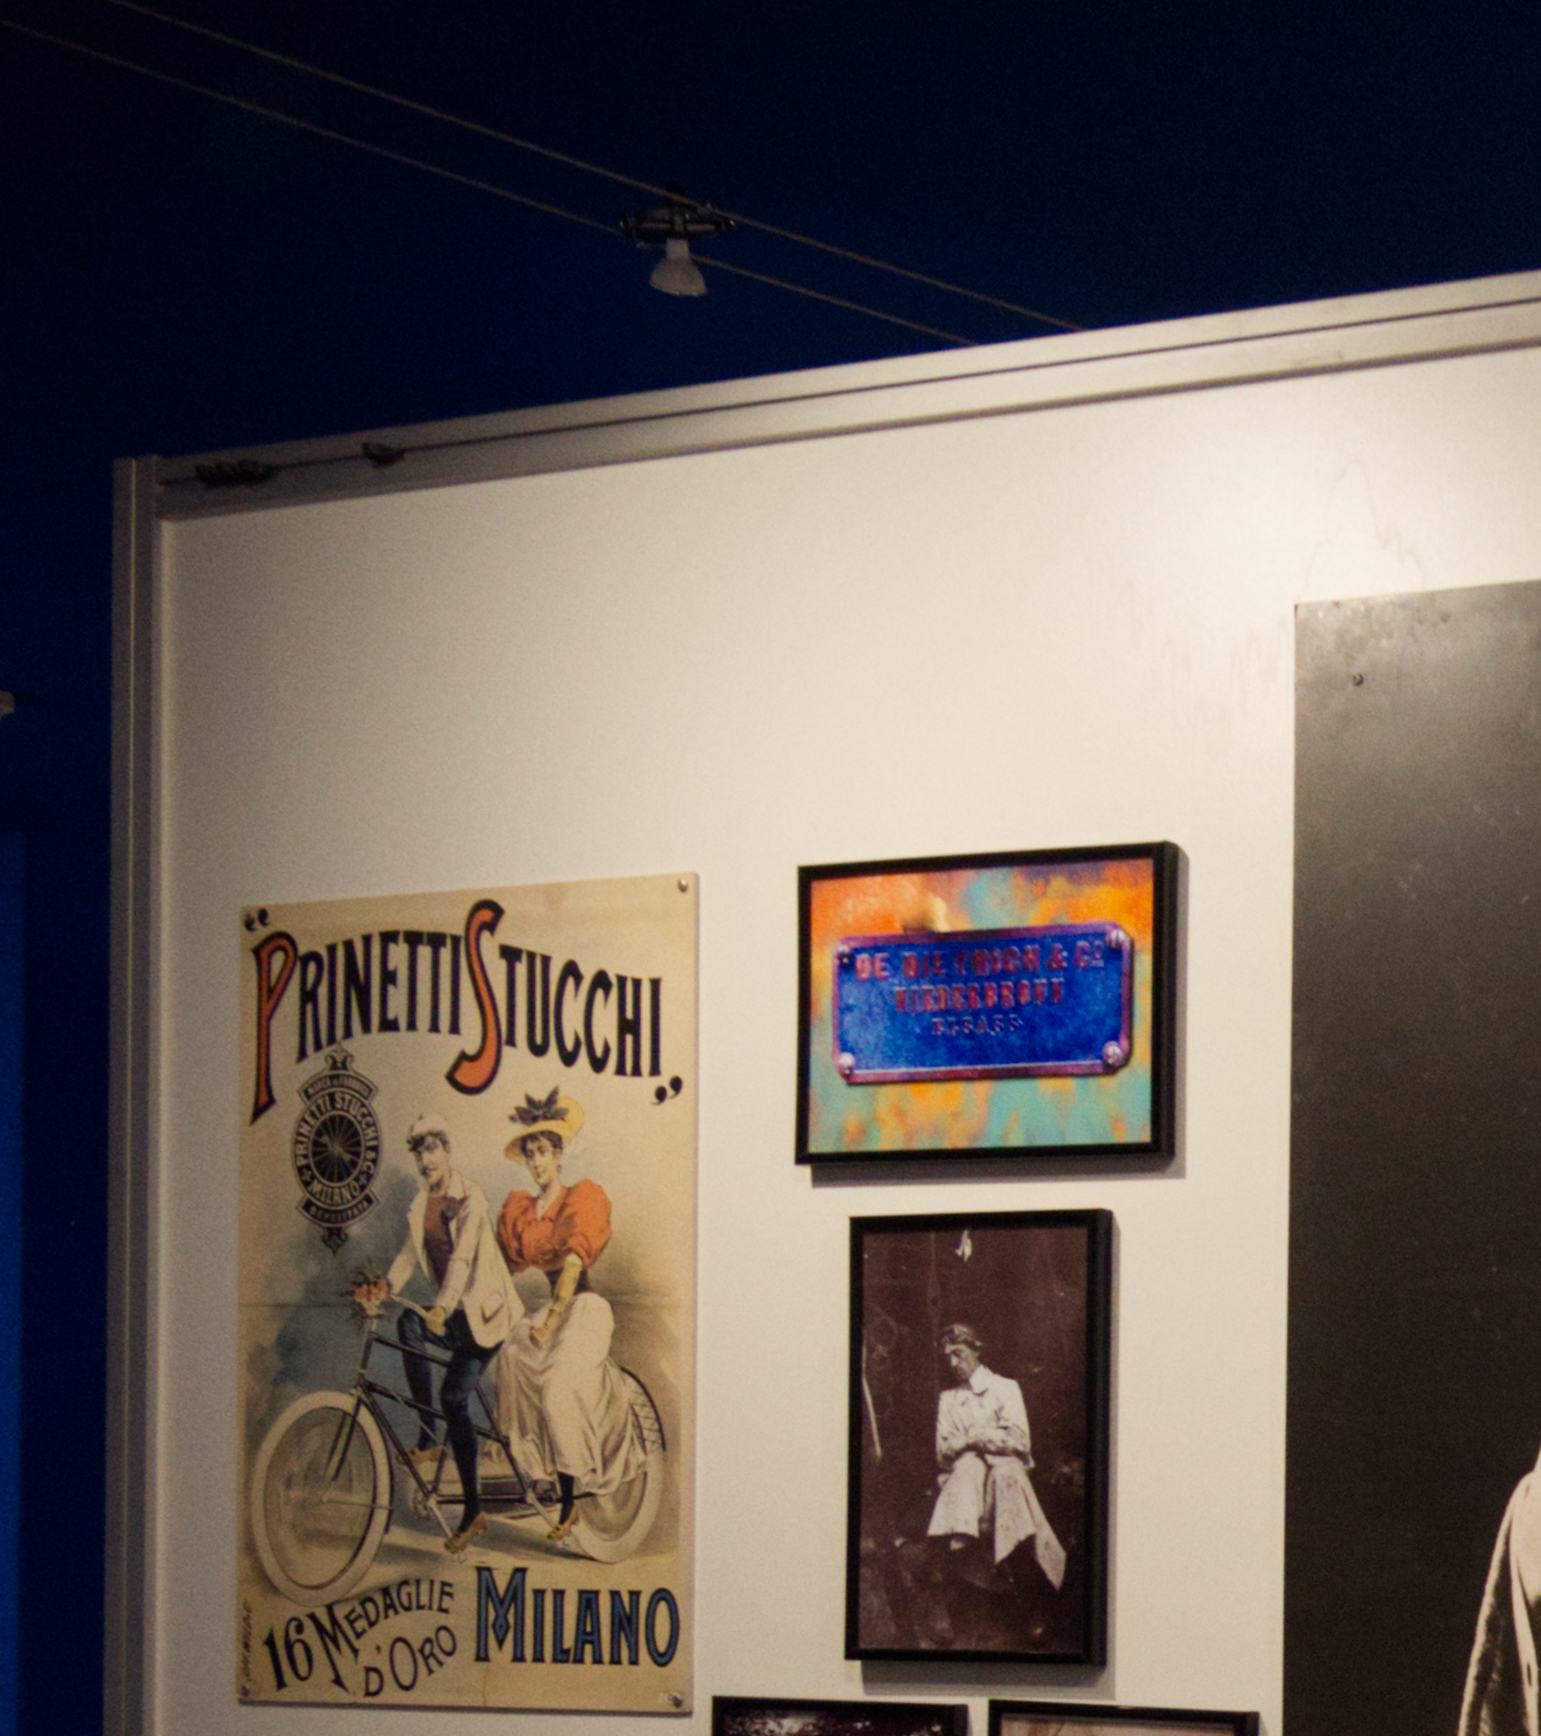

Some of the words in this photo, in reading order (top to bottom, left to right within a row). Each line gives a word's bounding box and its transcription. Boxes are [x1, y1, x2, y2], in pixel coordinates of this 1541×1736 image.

[855, 952, 890, 981] DE
[295, 1094, 332, 1167] PRINETTI
[333, 1091, 379, 1147] STUCCHI
[308, 1179, 361, 1205] MILANO
[262, 1616, 313, 1692] 16
[307, 1577, 455, 1694] MEDAGLIE
[473, 1565, 681, 1668] MILANO
